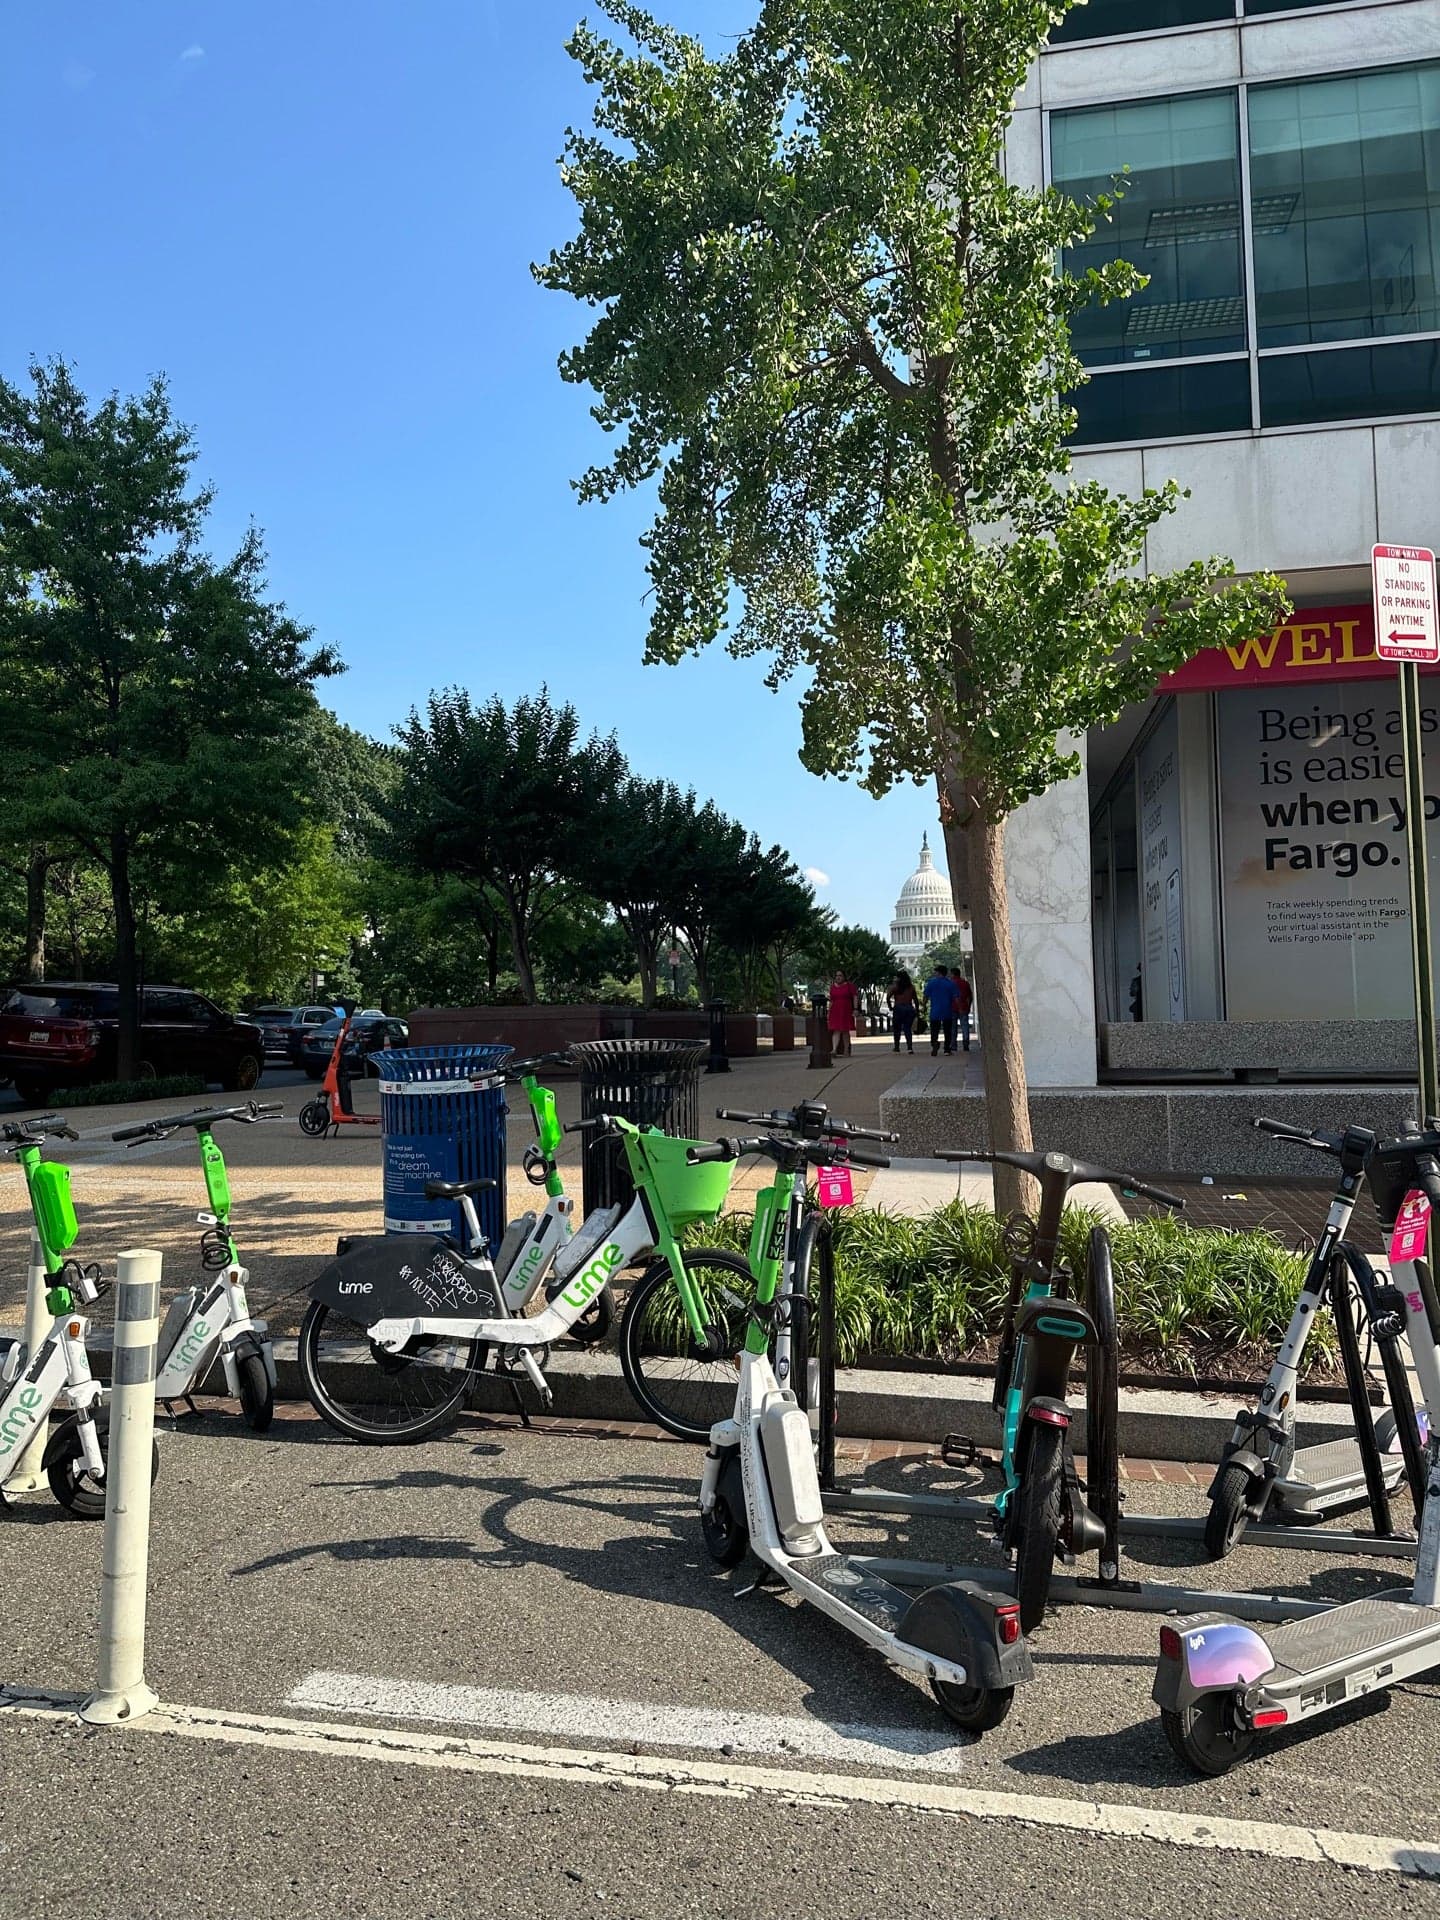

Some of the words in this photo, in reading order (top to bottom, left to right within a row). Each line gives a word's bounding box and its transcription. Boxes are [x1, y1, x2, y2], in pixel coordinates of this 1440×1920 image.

[1398, 562, 1410, 573] NO
[1384, 578, 1426, 592] STANDING
[1381, 595, 1393, 606] OR
[1394, 597, 1431, 609] PARKING
[1389, 614, 1425, 627] ANYTIME
[1222, 620, 1380, 670] WEL
[1258, 706, 1375, 747] Being
[1259, 752, 1293, 785] is
[1303, 745, 1426, 783] easie
[1260, 792, 1380, 828] when
[1264, 837, 1401, 878] Fargo.
[1266, 901, 1291, 909] Track
[1293, 899, 1323, 909] weekly
[1325, 898, 1367, 907] spending
[1369, 897, 1399, 905] trends
[1279, 911, 1297, 919] find
[1323, 910, 1333, 918] to
[1357, 909, 1378, 917] with
[1267, 925, 1287, 933] your
[1289, 922, 1319, 931] virtual
[1320, 921, 1361, 930] assistant
[1363, 921, 1372, 929] in
[1373, 919, 1389, 928] the
[1267, 934, 1292, 943] Wells
[1294, 933, 1320, 944] Fargo
[398, 1161, 430, 1171] dream
[509, 1245, 543, 1291] Lime
[561, 1243, 625, 1308] Lime
[338, 1281, 374, 1294] Lime
[168, 1320, 211, 1372] Lime
[855, 1586, 899, 1614] Lime
